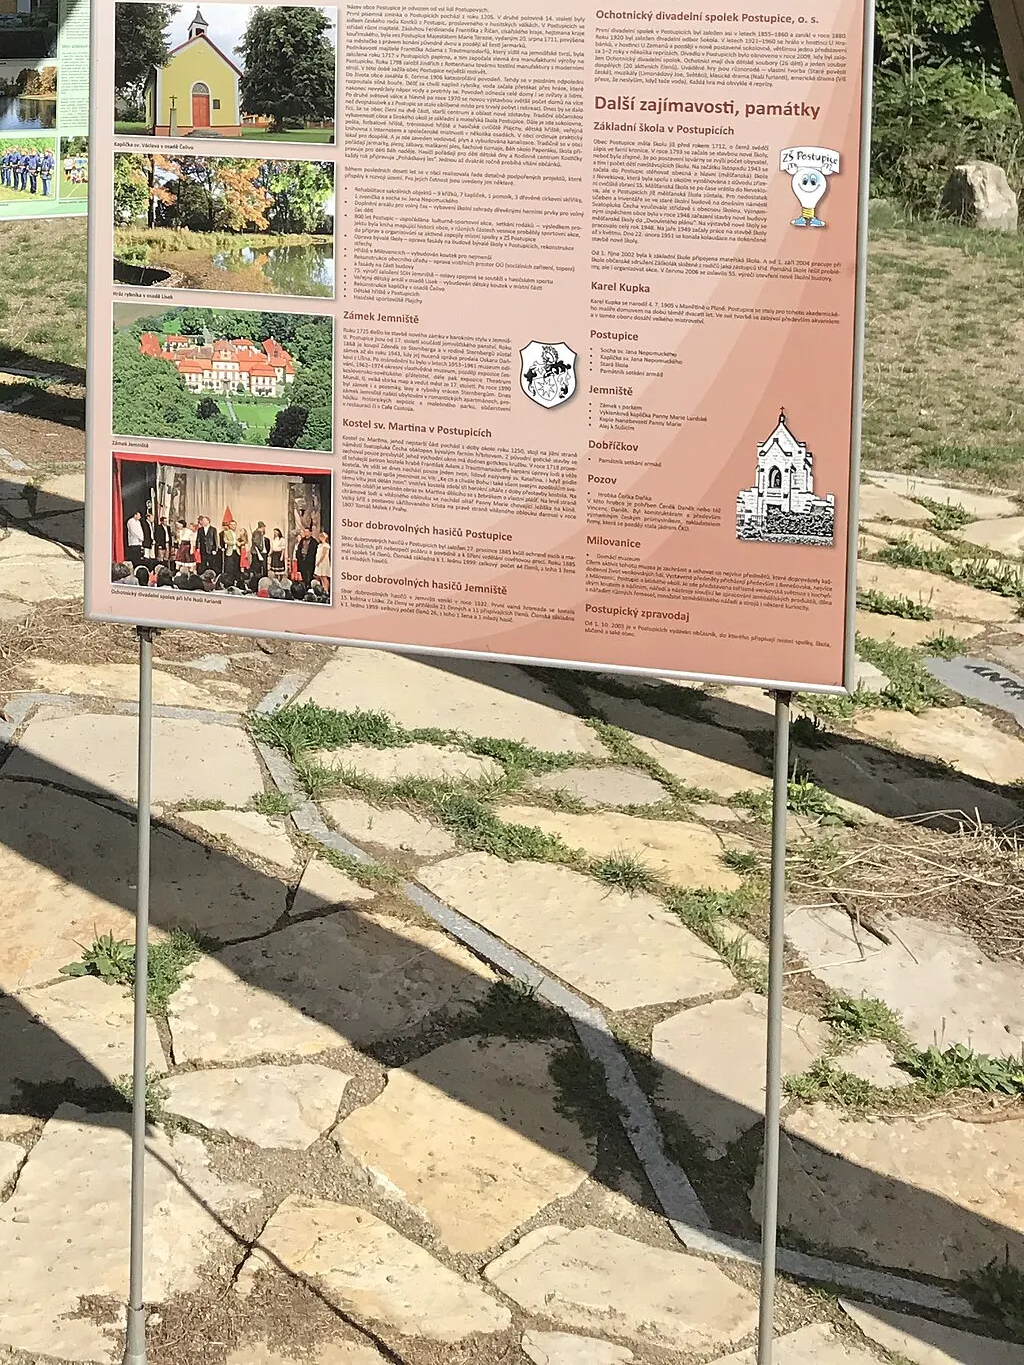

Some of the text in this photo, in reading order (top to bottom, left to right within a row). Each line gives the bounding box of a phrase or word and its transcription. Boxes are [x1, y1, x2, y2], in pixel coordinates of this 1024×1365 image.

[596, 10, 653, 22] Ochotnický
[655, 11, 703, 21] divadelní
[705, 12, 739, 23] spolek
[742, 14, 794, 24] Postupice,
[595, 96, 820, 120] Další zajímavosti, památky
[594, 122, 636, 132] Základní
[639, 123, 665, 132] škola
[676, 125, 734, 136] Postupicích
[783, 150, 838, 164] ZŠ Postupice
[591, 281, 650, 294] Karel Kupka
[343, 311, 419, 324] Zámek Jemniště
[590, 330, 638, 342] Postupice
[589, 385, 633, 396] Jemniště
[343, 418, 371, 428] Kostel
[388, 422, 426, 432] Martina
[437, 426, 492, 438] Postupicích
[588, 440, 638, 452] Dobříčkov
[588, 474, 617, 484] Pozov
[342, 518, 512, 541] Sbor dobrovolných hasičů Postupice
[587, 536, 641, 548] Milovanice
[341, 572, 507, 595] Sbor dobrovolných hasičů Jemniště
[586, 604, 689, 622] Postupický zpravodaj
